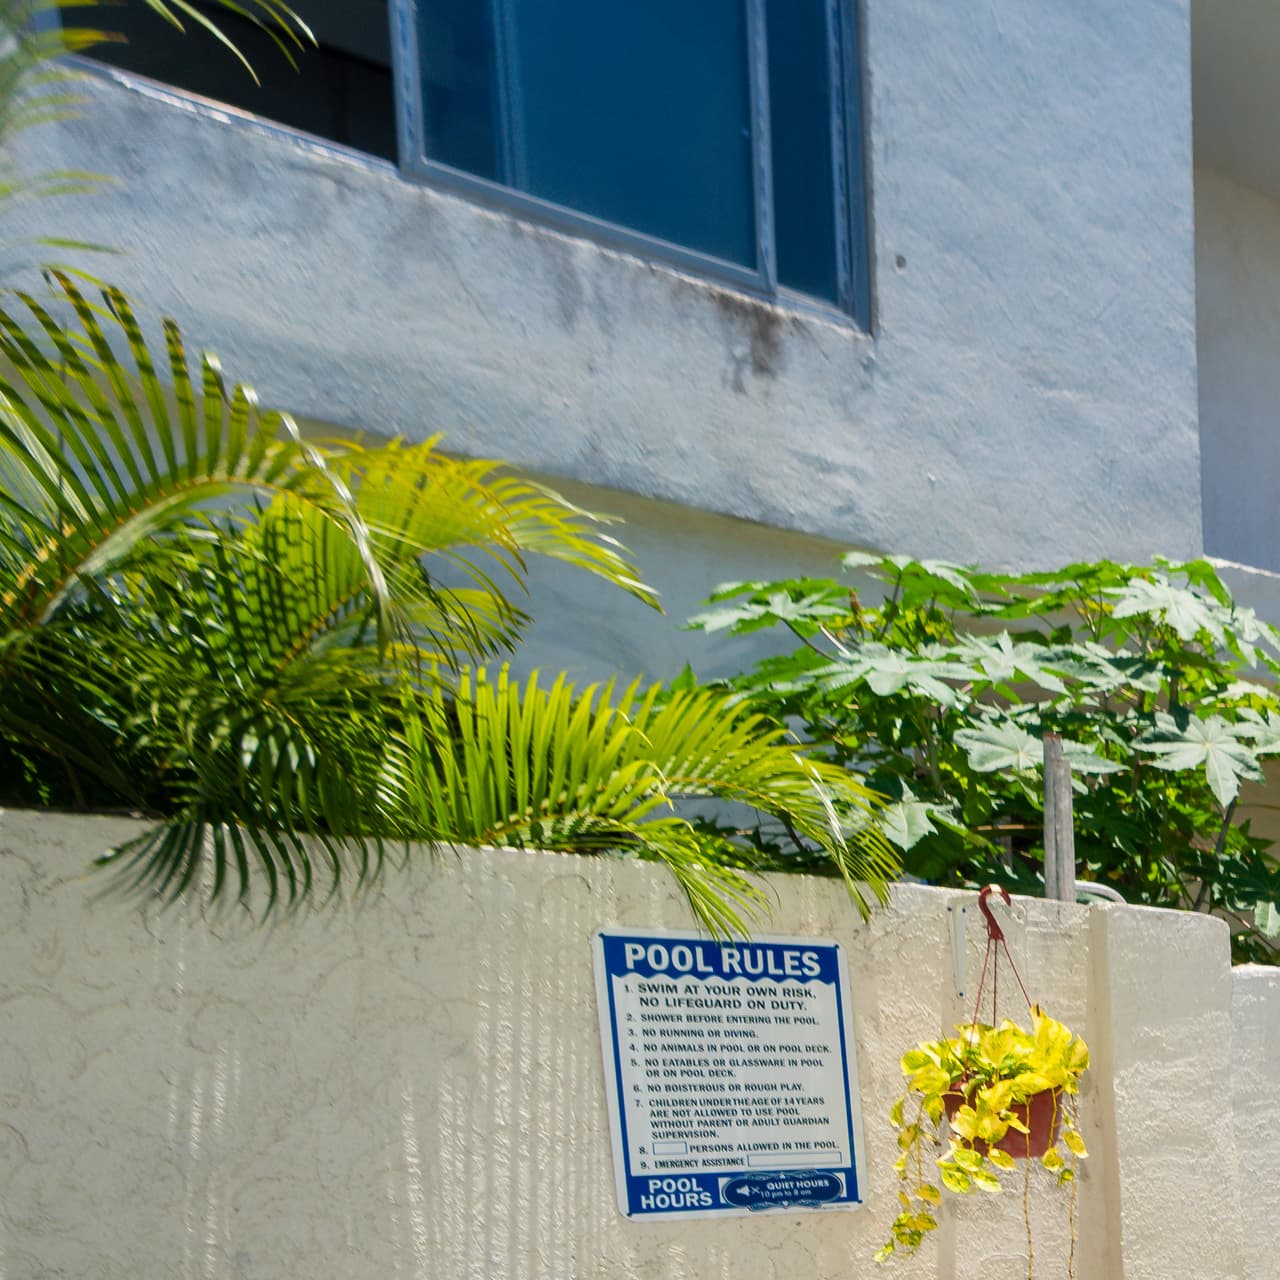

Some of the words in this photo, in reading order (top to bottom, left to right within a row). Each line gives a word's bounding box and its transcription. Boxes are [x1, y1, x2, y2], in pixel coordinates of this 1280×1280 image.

[624, 943, 714, 973] POOL
[721, 947, 821, 977] RULES
[624, 984, 633, 993] 1.
[638, 984, 678, 994] SWIM
[684, 986, 700, 995] AT
[704, 986, 740, 996] YOUR
[746, 988, 777, 997] OWN
[640, 997, 659, 1007] NO
[665, 998, 741, 1009] LIFEGUARD
[747, 1000, 765, 1009] ON
[771, 1001, 807, 1011] DUTY.
[626, 1013, 635, 1021] 2.
[640, 1014, 683, 1023] SHOWER
[686, 1015, 722, 1023] BEFORE
[726, 1016, 771, 1024] ENTERING
[794, 1017, 820, 1025] POOL.
[660, 1029, 705, 1037] RUNNING
[724, 1030, 758, 1039] DIVING.
[629, 1044, 639, 1052] 4.
[643, 1044, 657, 1052] NO
[661, 1044, 704, 1052] ANIMALS
[707, 1044, 717, 1052] IN
[720, 1044, 744, 1053] POOL
[747, 1045, 760, 1053] OR
[763, 1045, 776, 1053] ON
[779, 1045, 802, 1053] POOL
[805, 1045, 832, 1054] DECK.
[645, 1059, 658, 1067] NO
[662, 1058, 709, 1067] EATABLES
[712, 1059, 725, 1067] OR
[729, 1059, 785, 1067] GLASSWARE
[788, 1059, 797, 1067] IN
[800, 1059, 824, 1067] POOL
[680, 1070, 705, 1078] POOL
[708, 1069, 737, 1078] DECK.
[647, 1084, 662, 1092] NO
[664, 1084, 724, 1092] BOISTEROUS
[728, 1084, 741, 1092] OR
[780, 1083, 804, 1091] PLAY.
[634, 1099, 643, 1108] 7.
[649, 1099, 699, 1107] CHILDREN
[699, 1098, 732, 1106] UNDER
[733, 1098, 751, 1106] THE
[751, 1098, 769, 1106] AGE
[795, 1097, 824, 1105] YEARS
[650, 1109, 669, 1117] ARE
[672, 1109, 691, 1117] NOT
[694, 1109, 737, 1117] ALLOWED
[755, 1108, 773, 1116] USE
[650, 1120, 694, 1128] WITHOUT
[697, 1119, 733, 1127] PARENT
[735, 1119, 749, 1127] OR
[752, 1118, 780, 1126] ADULT
[783, 1117, 830, 1126] GUARDIAN
[652, 1130, 719, 1139] SUPERVISION.
[639, 1147, 648, 1155] 8.
[689, 1144, 734, 1153] PERSONS
[736, 1143, 779, 1152] ALLOWED
[814, 1141, 839, 1149] POOL.
[640, 1161, 649, 1169] 9.
[654, 1159, 698, 1169] EMERGENCY
[701, 1158, 745, 1167] ASSISTANCE
[648, 1177, 703, 1194] POOL
[766, 1181, 795, 1190] QUIET
[796, 1180, 829, 1189] HOURS
[760, 1190, 771, 1199] 10
[783, 1189, 792, 1197] to
[640, 1192, 713, 1209] HOURS
